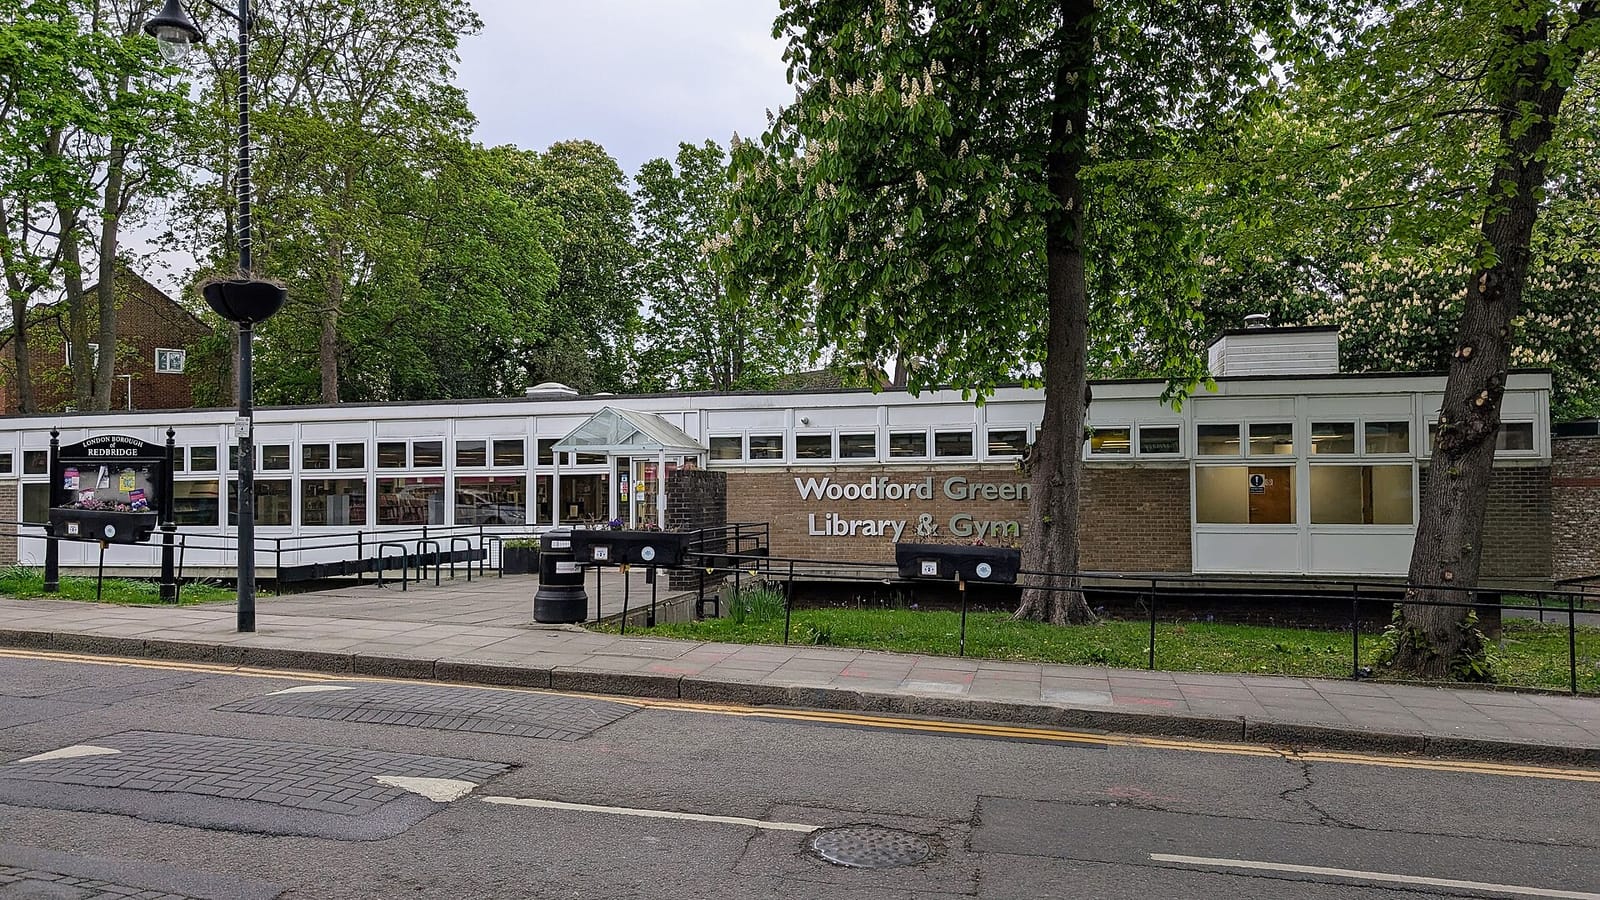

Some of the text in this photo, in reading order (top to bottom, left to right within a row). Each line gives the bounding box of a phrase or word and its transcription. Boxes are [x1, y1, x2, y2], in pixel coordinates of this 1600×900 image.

[82, 436, 144, 448] LONDON BOROUGH
[88, 448, 138, 456] REDBRIDGE
[794, 476, 1032, 501] Woodford Green
[808, 513, 1020, 543] Library & Gym
